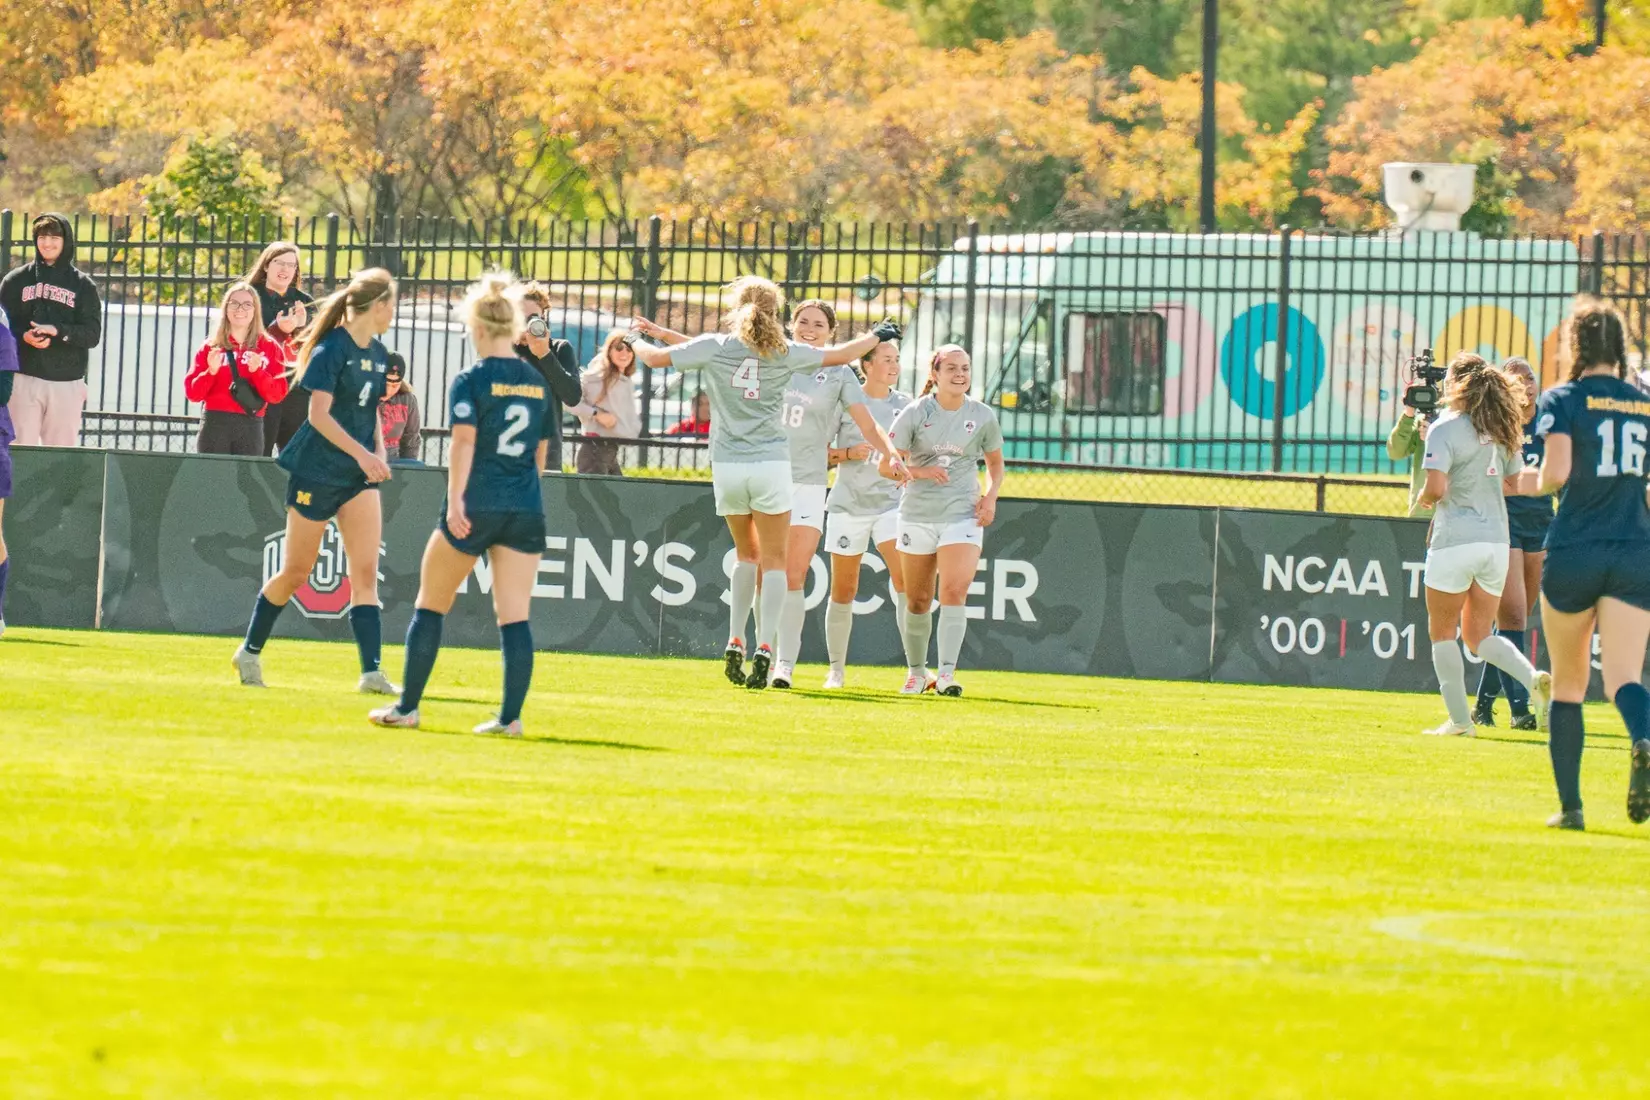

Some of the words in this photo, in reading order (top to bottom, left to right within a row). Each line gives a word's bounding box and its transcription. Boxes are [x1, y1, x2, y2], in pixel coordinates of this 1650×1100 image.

[22, 282, 43, 302] OHO
[43, 283, 76, 308] STATE
[359, 382, 372, 407] 4
[491, 384, 544, 400] MICHIGAN
[731, 356, 760, 400] 4
[496, 405, 530, 457] 2
[781, 402, 804, 427] 18
[1596, 418, 1648, 477] 16
[296, 490, 312, 506] M
[719, 546, 1039, 623] SCER
[1262, 553, 1389, 597] NCAA
[1260, 615, 1326, 656] '00
[1362, 620, 1416, 660] '01
